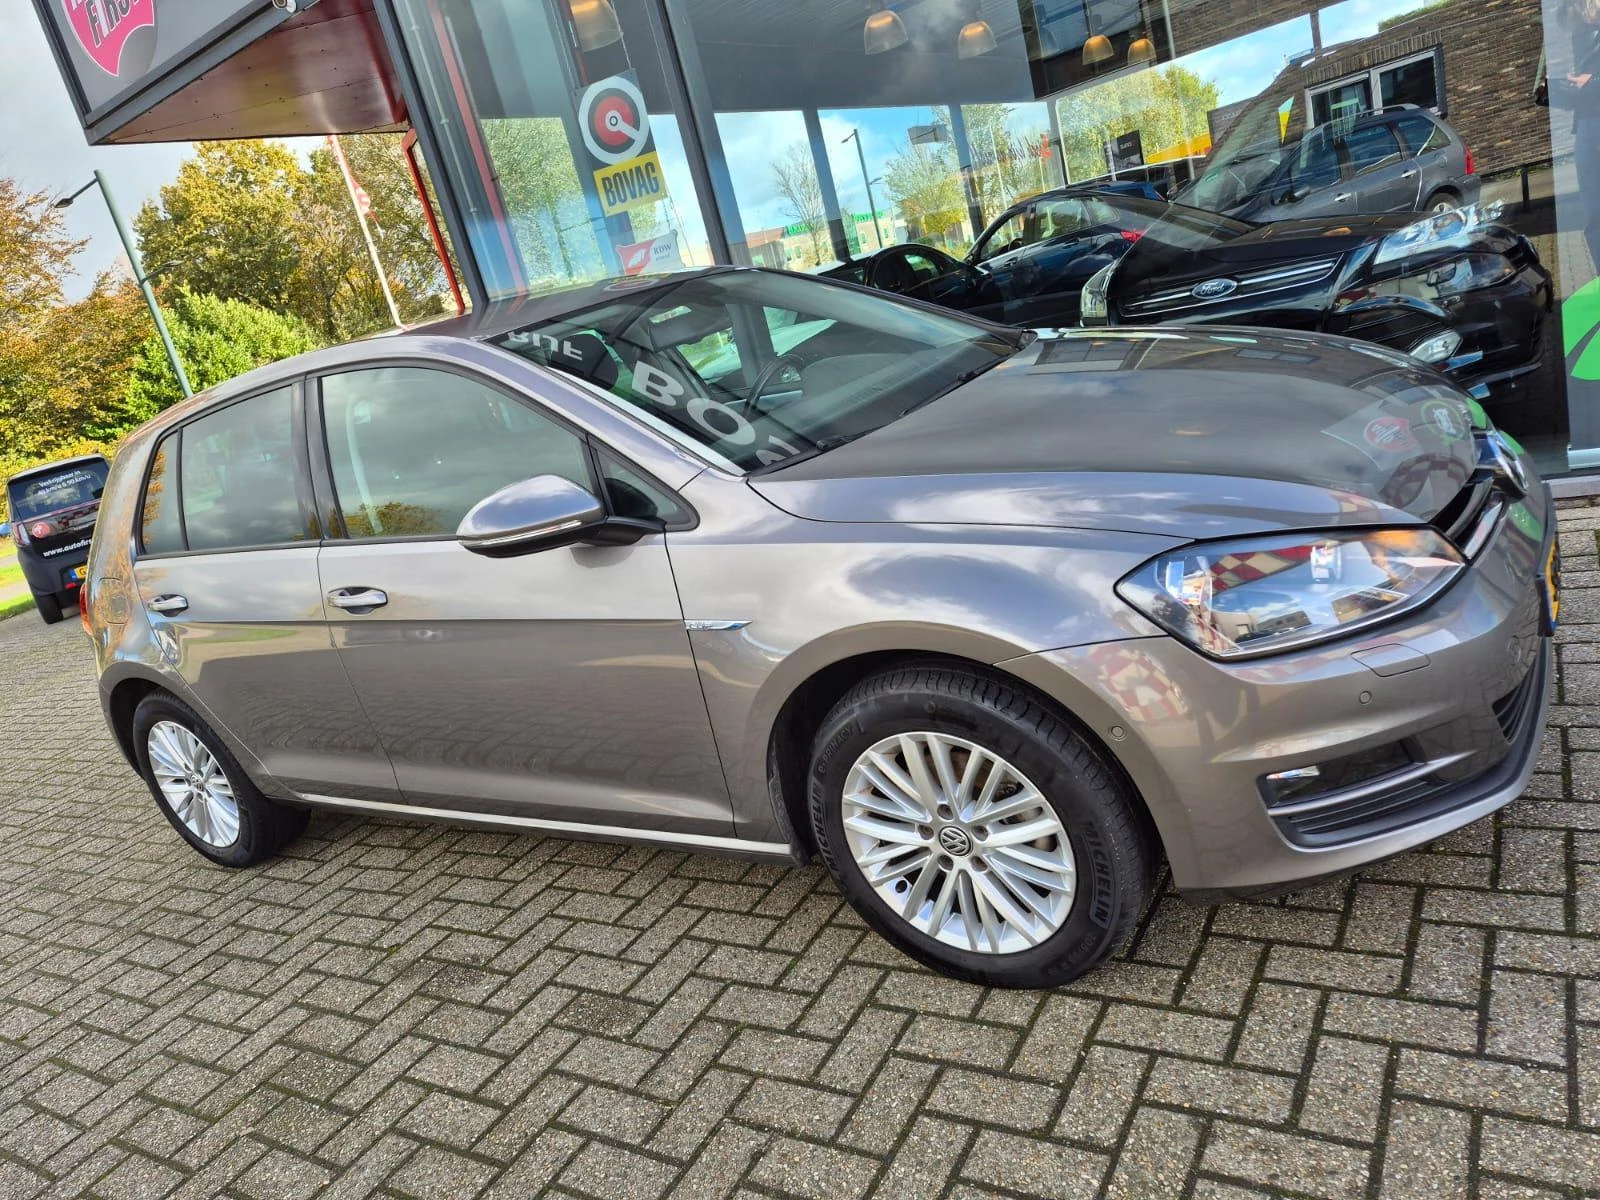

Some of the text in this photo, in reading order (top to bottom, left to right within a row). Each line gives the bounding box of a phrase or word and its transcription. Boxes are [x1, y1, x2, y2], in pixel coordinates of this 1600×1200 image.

[85, 0, 139, 48] FIR
[601, 161, 660, 206] BOVAG
[1200, 281, 1225, 295] Ford
[811, 782, 839, 872] MICHELIN
[1081, 820, 1112, 925] MICHELIN
